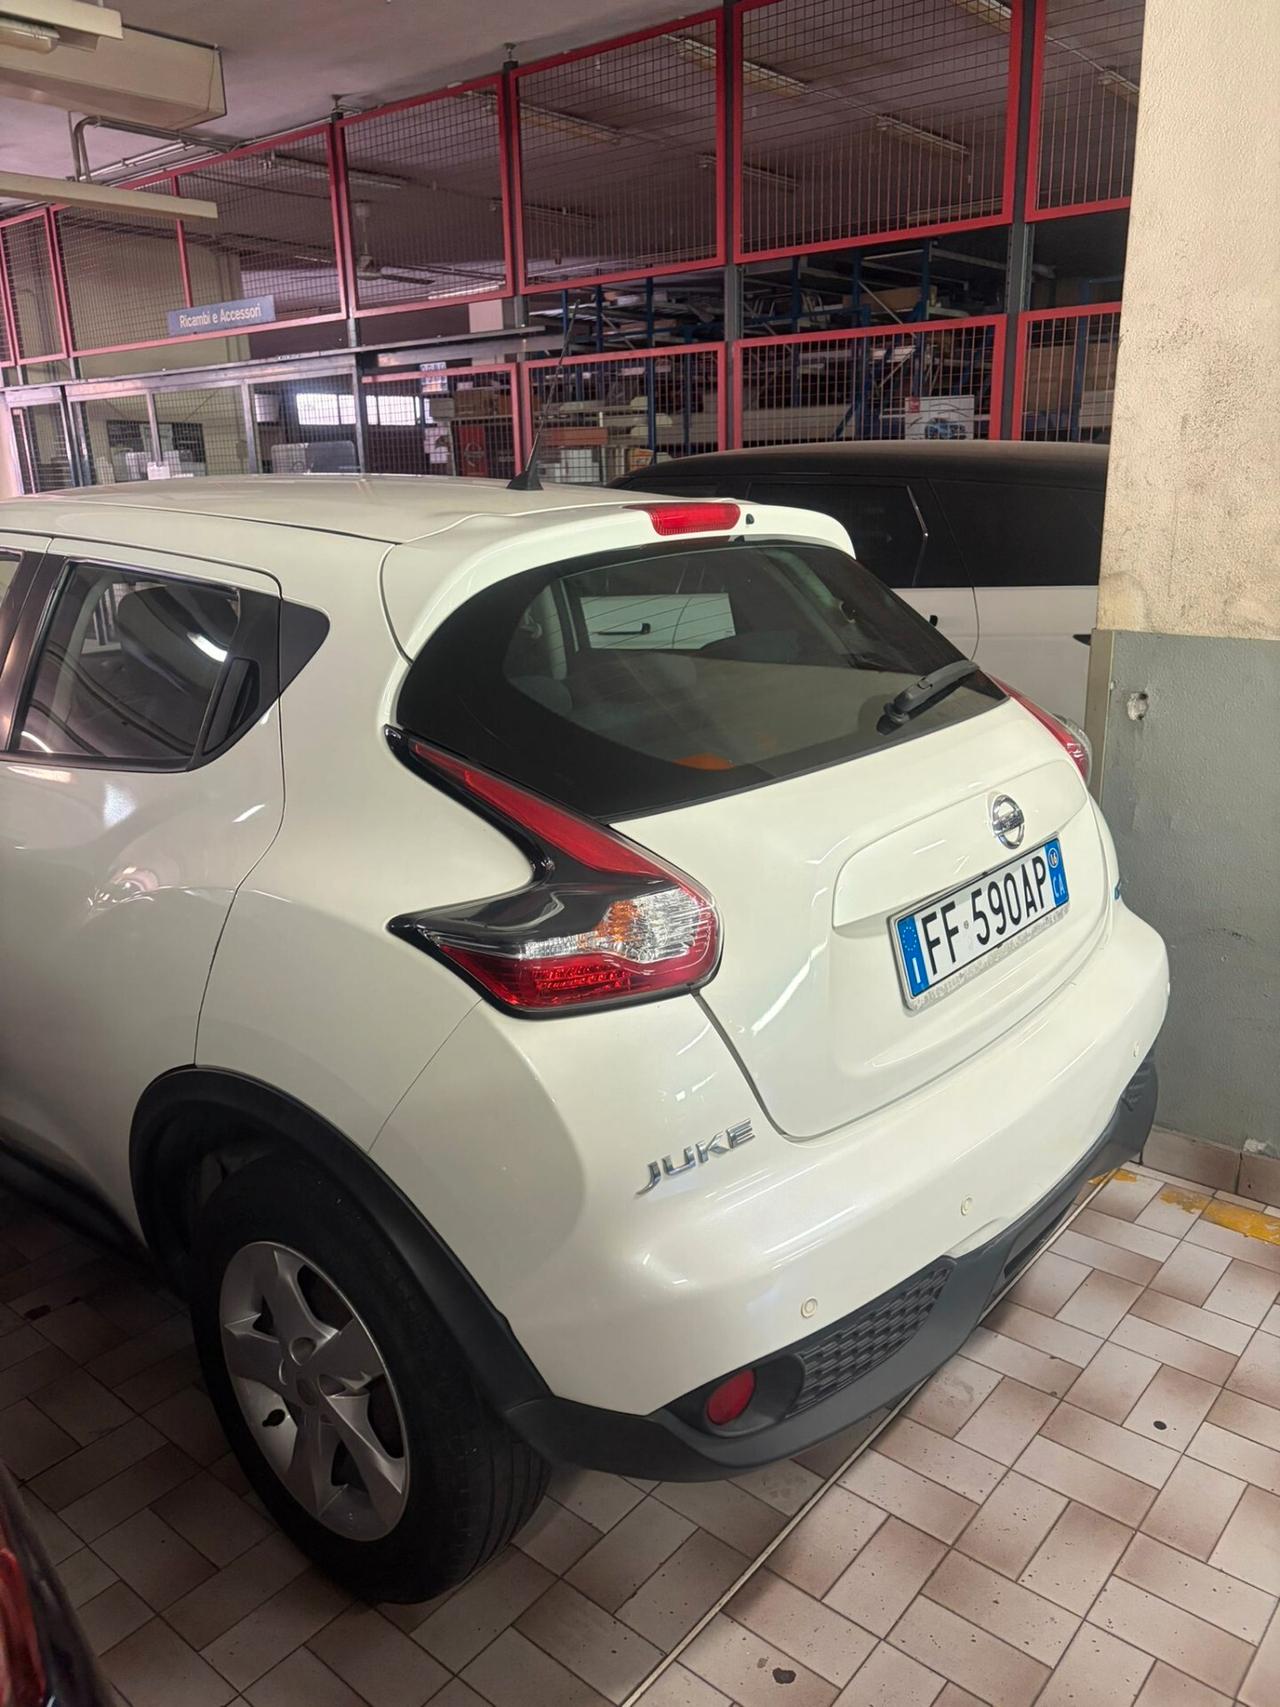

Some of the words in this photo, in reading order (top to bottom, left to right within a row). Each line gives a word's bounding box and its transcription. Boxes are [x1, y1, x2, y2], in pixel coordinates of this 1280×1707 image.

[180, 310, 210, 328] Ricambi
[212, 313, 218, 324] e
[220, 303, 262, 322] Accessori
[1053, 873, 1066, 898] CA
[921, 901, 959, 975] FF
[971, 856, 1046, 945] 590AP
[912, 957, 921, 984] I
[635, 1119, 755, 1196] JUKE
